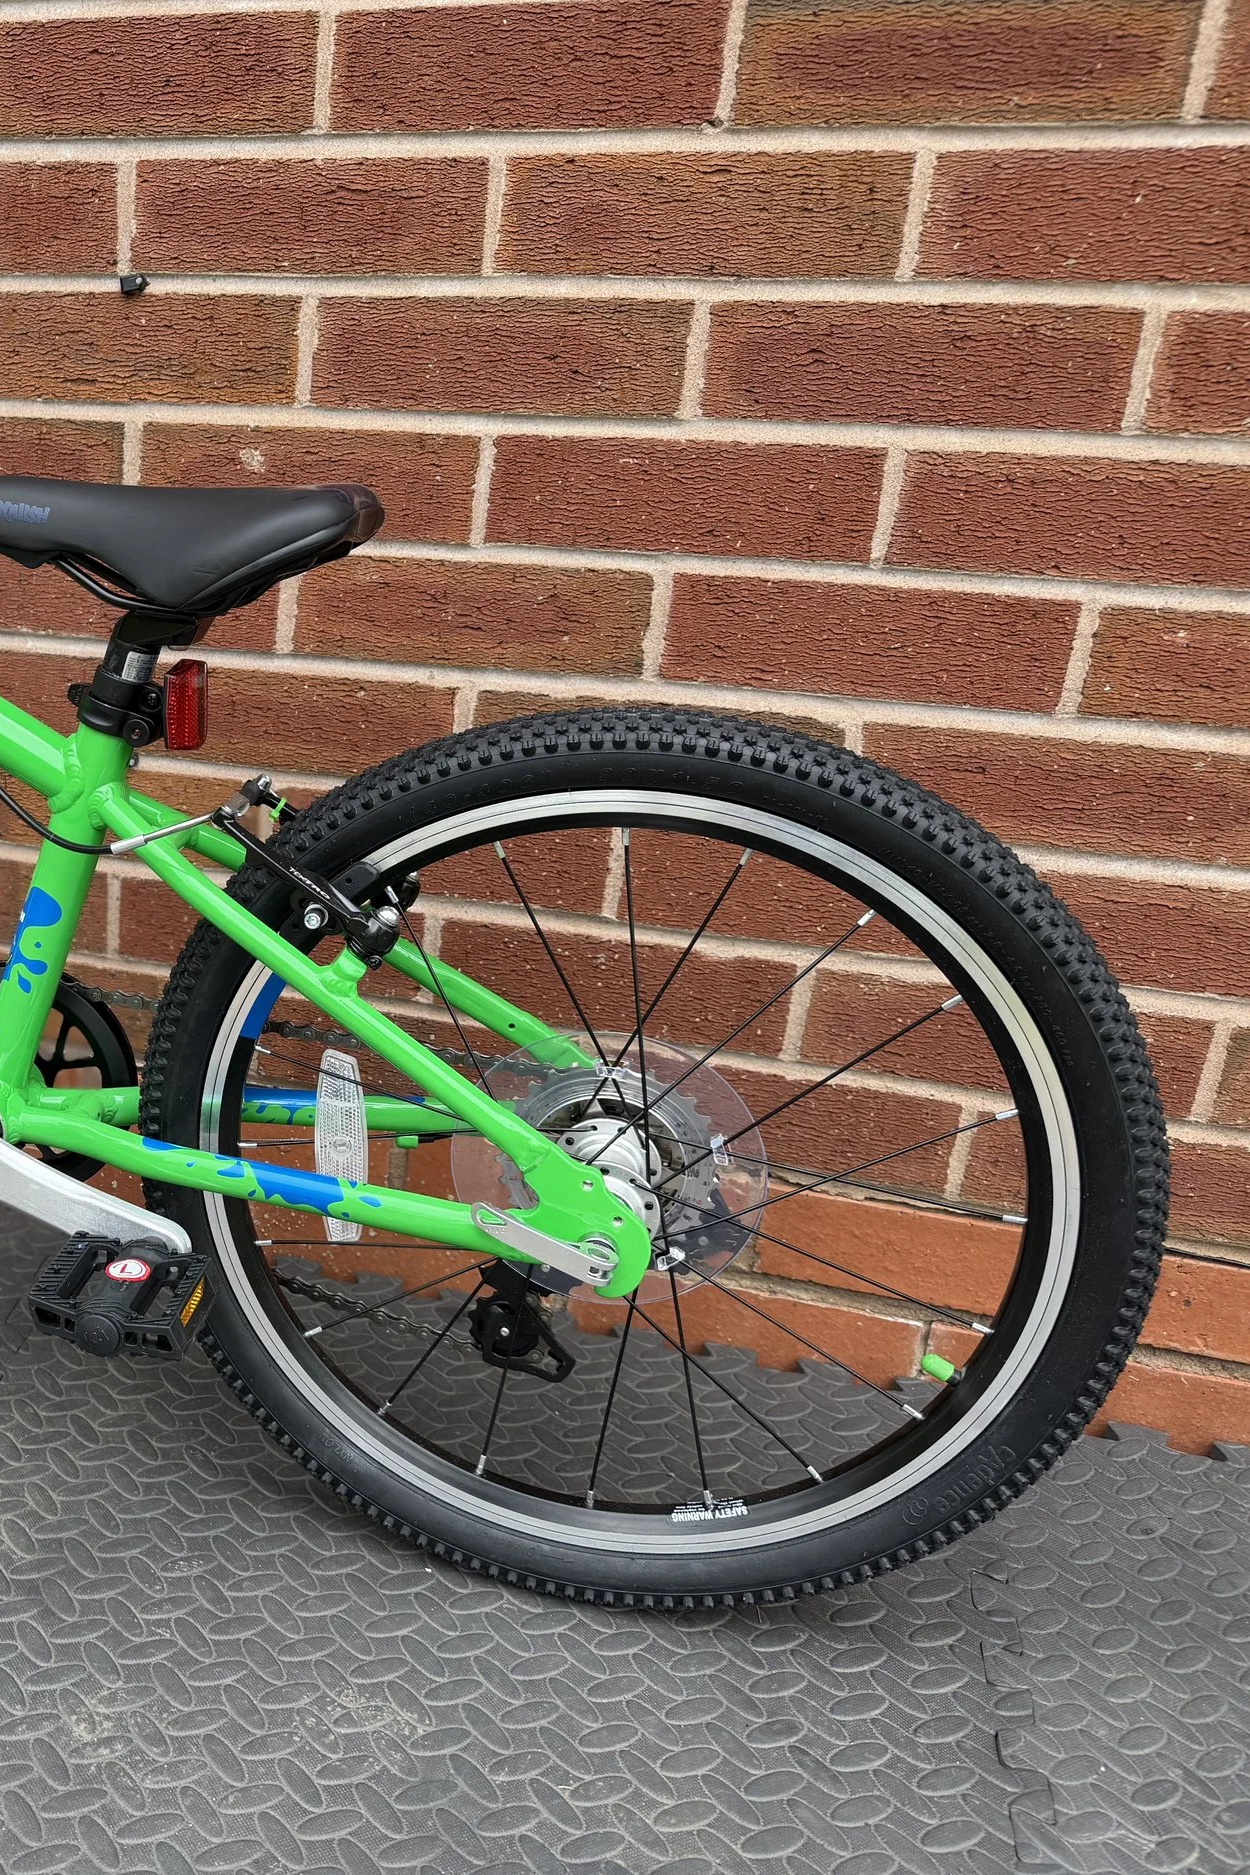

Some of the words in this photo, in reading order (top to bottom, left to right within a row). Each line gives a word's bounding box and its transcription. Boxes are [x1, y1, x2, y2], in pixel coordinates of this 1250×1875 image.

[289, 866, 331, 900] TEKTRO
[119, 1263, 133, 1275] L
[671, 1509, 715, 1523] WARNING
[714, 1504, 749, 1520] SAFETY
